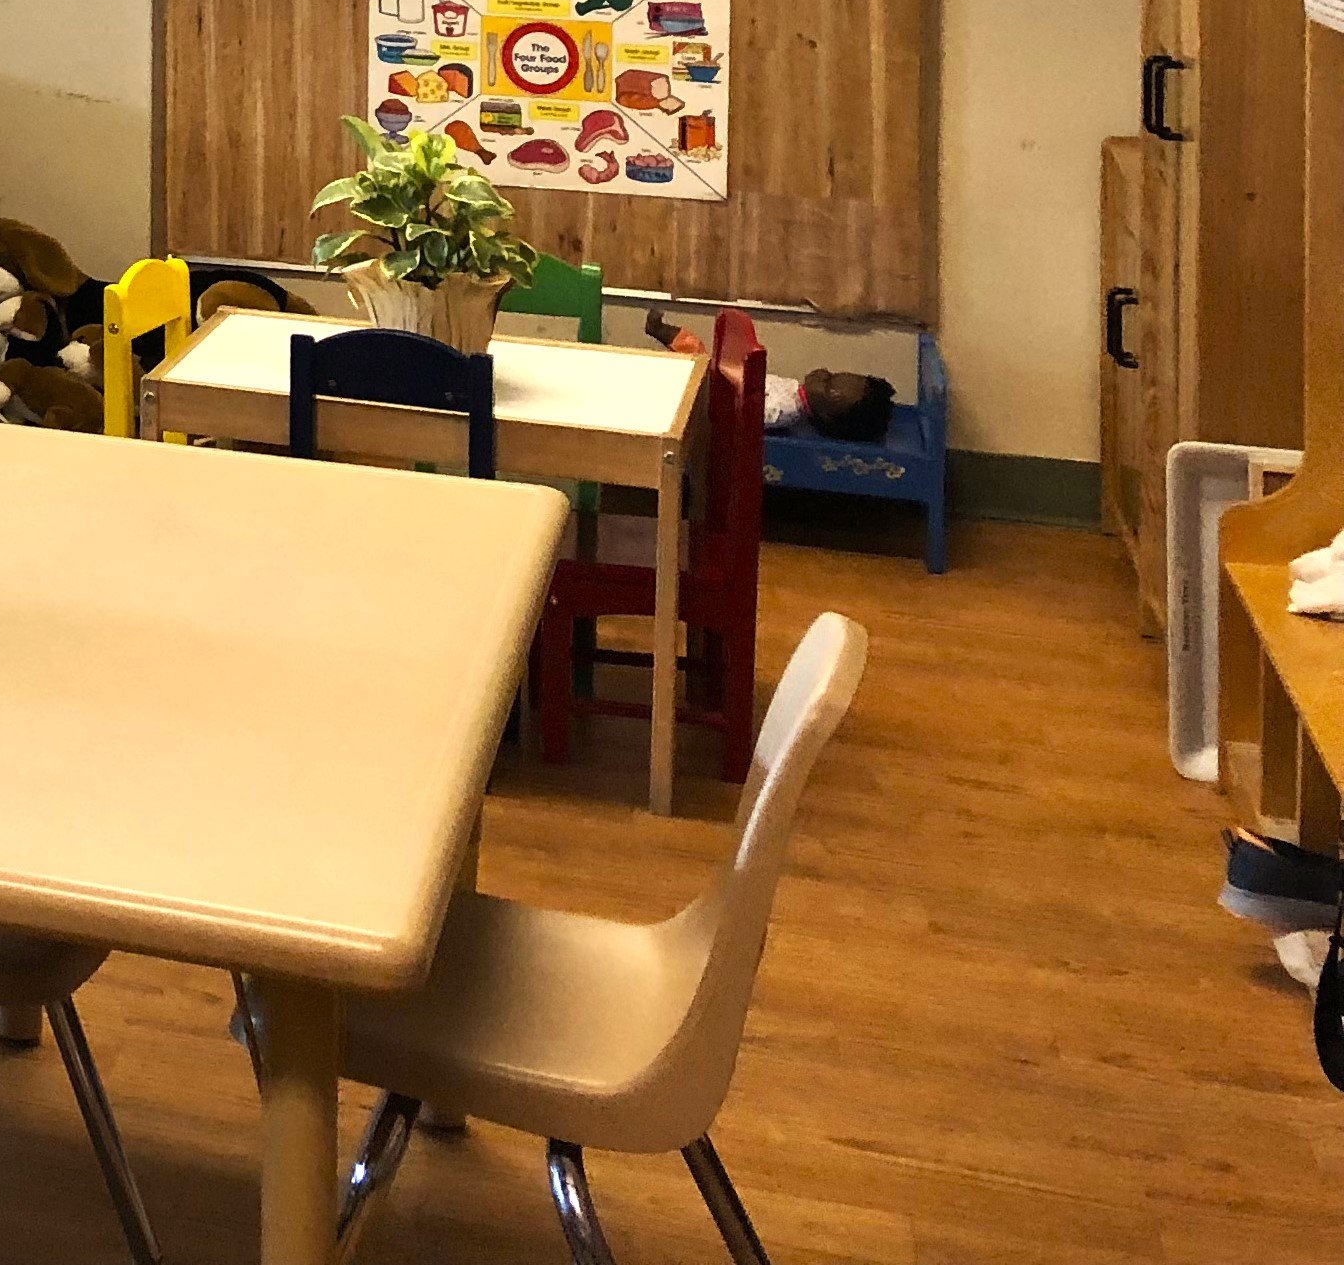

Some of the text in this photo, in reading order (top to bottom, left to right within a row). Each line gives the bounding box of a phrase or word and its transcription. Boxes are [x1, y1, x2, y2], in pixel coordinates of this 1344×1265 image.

[532, 44, 550, 52] The
[514, 53, 567, 64] Four Food
[521, 64, 559, 75] Groups
